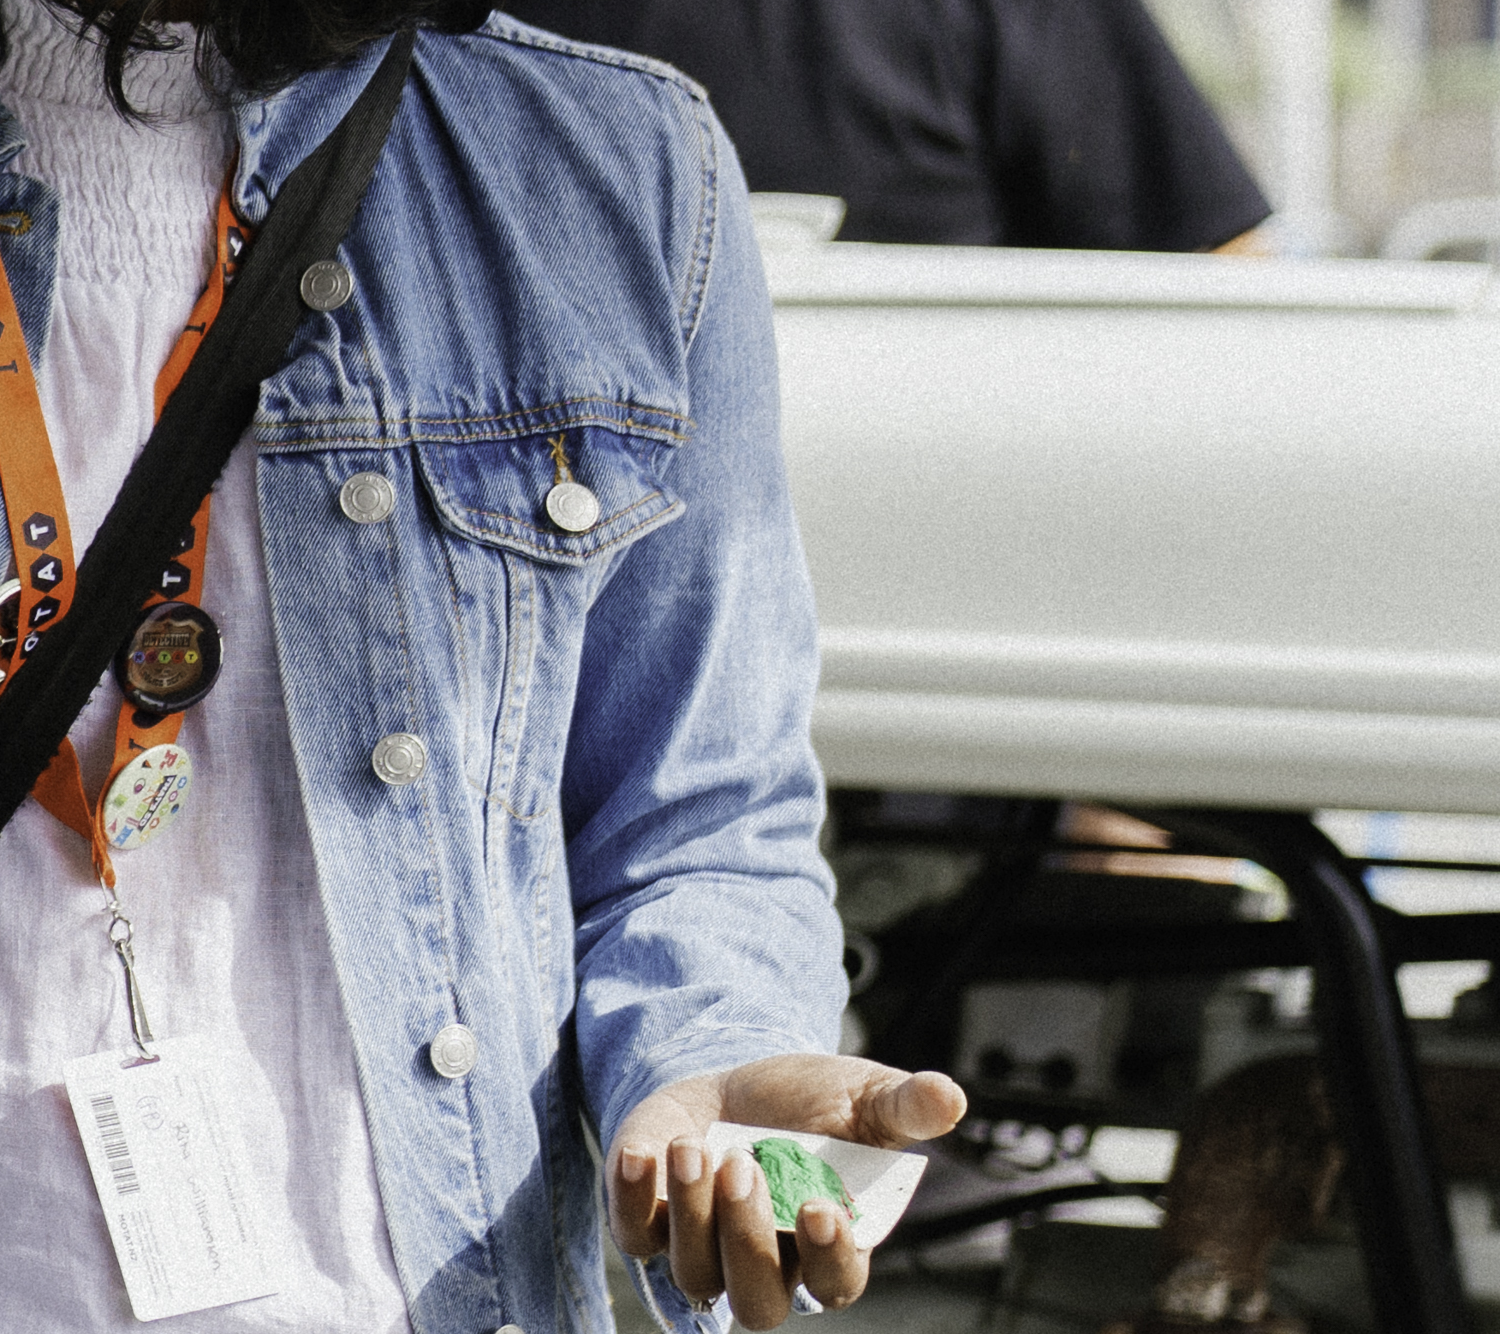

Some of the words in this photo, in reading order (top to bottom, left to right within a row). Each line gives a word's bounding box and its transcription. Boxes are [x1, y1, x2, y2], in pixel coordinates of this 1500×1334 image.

[23, 522, 57, 653] OTAT
[143, 633, 190, 646] DETECTIVE
[134, 652, 197, 663] MOTAT
